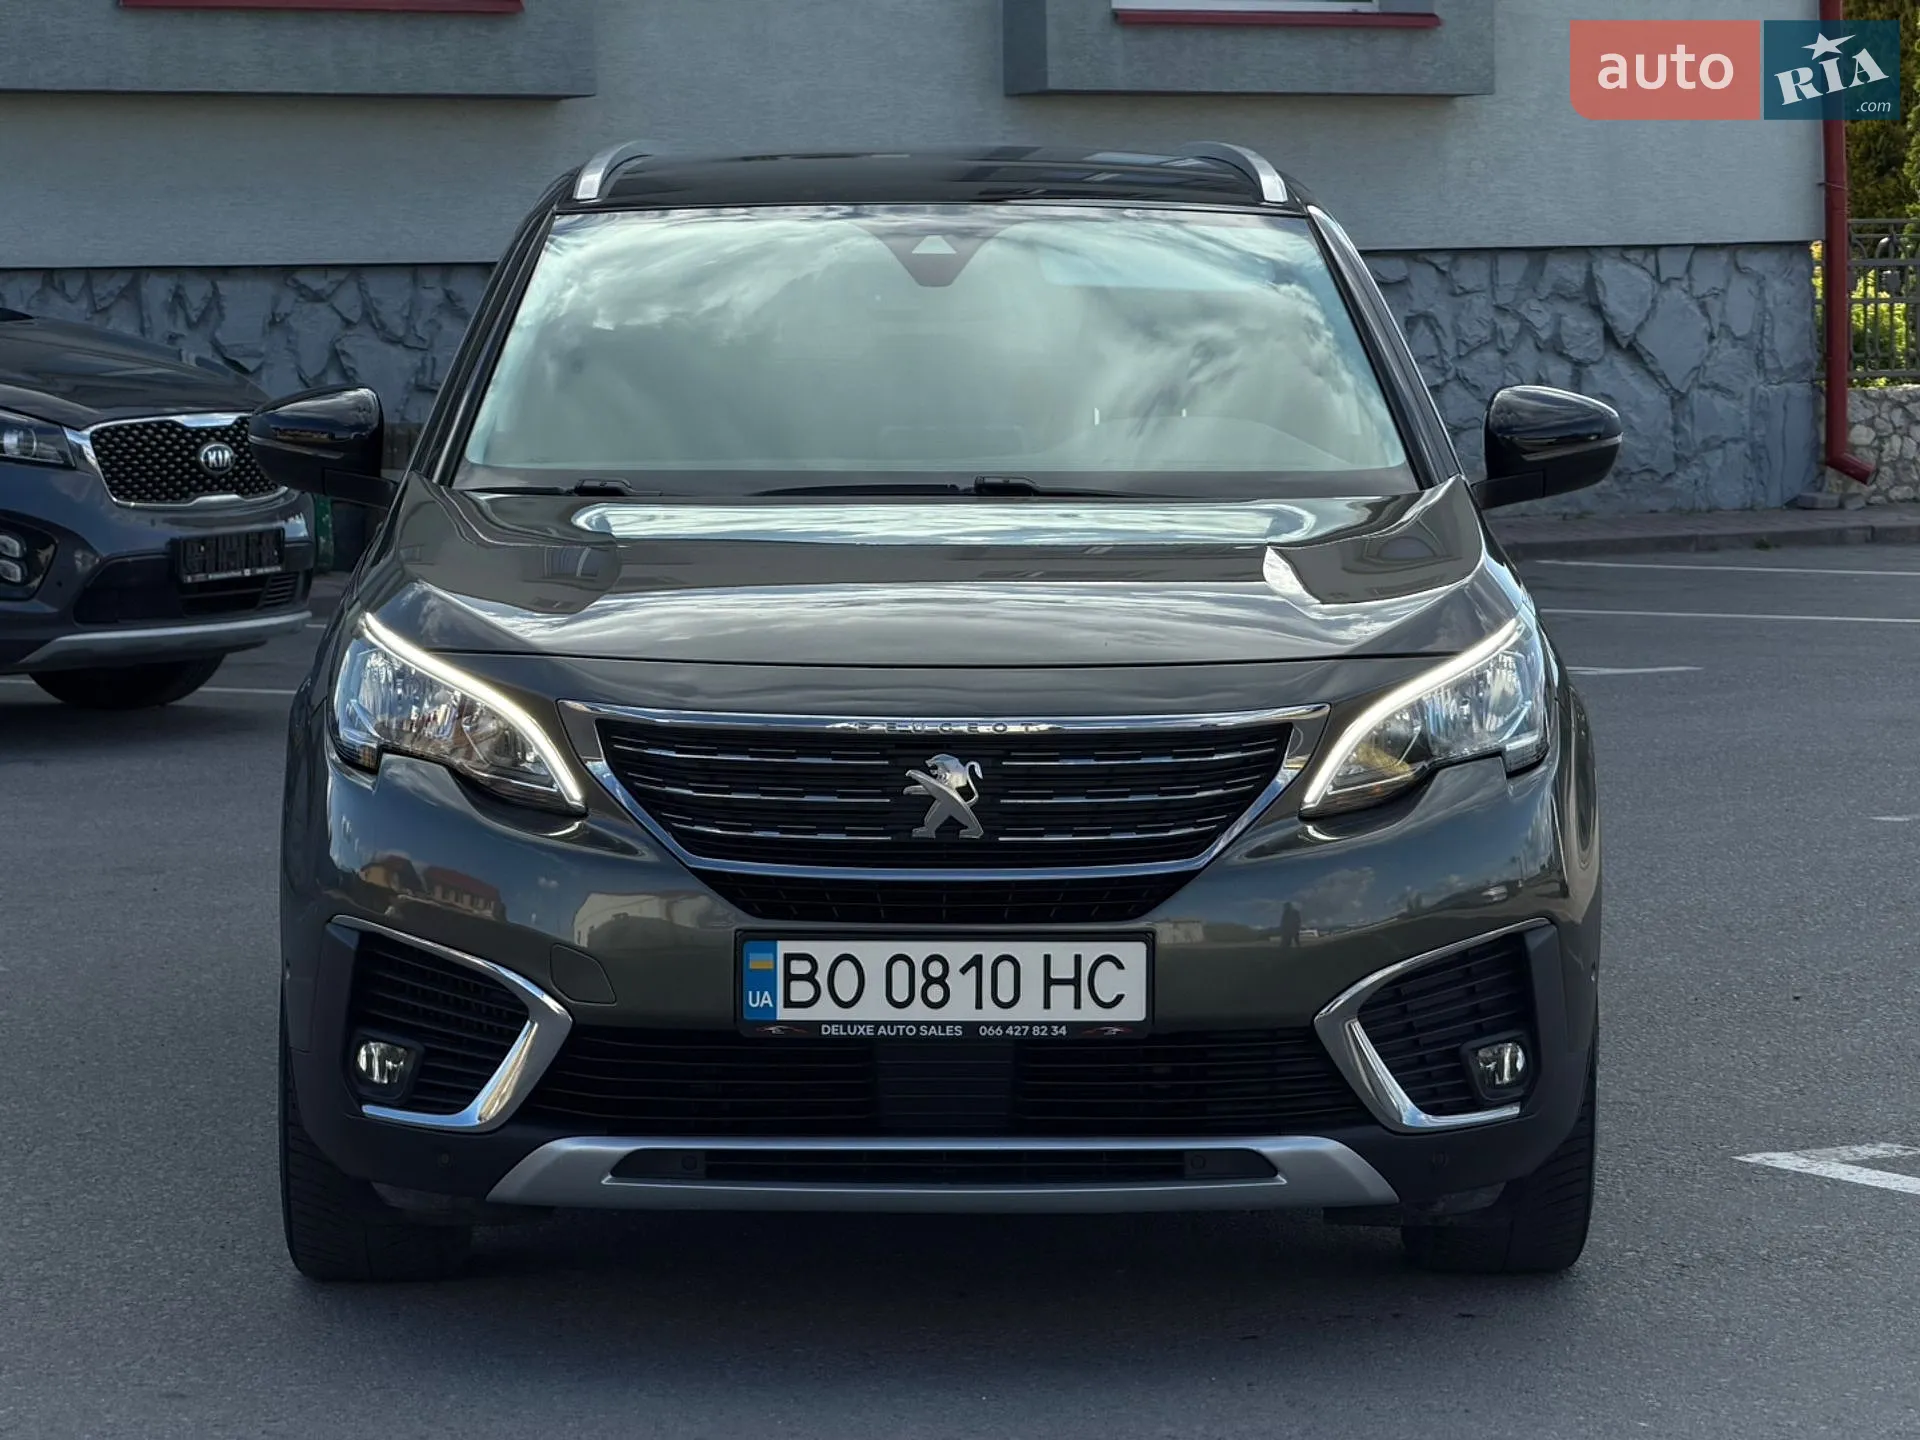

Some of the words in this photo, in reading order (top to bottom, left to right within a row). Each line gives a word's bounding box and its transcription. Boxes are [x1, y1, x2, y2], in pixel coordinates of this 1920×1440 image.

[207, 450, 231, 467] KIA
[857, 722, 1033, 734] PEUGEOT
[783, 952, 866, 1009] BO
[885, 953, 1022, 1010] 0810
[1042, 953, 1126, 1010] HC
[748, 990, 774, 1008] UA
[820, 1024, 875, 1036] DELUXE
[877, 1025, 917, 1036] AUTO
[919, 1025, 963, 1036] SALES
[978, 1025, 1003, 1036] 066
[1005, 1025, 1029, 1036] 427
[1031, 1025, 1048, 1036] 82
[1050, 1025, 1067, 1036] 34
